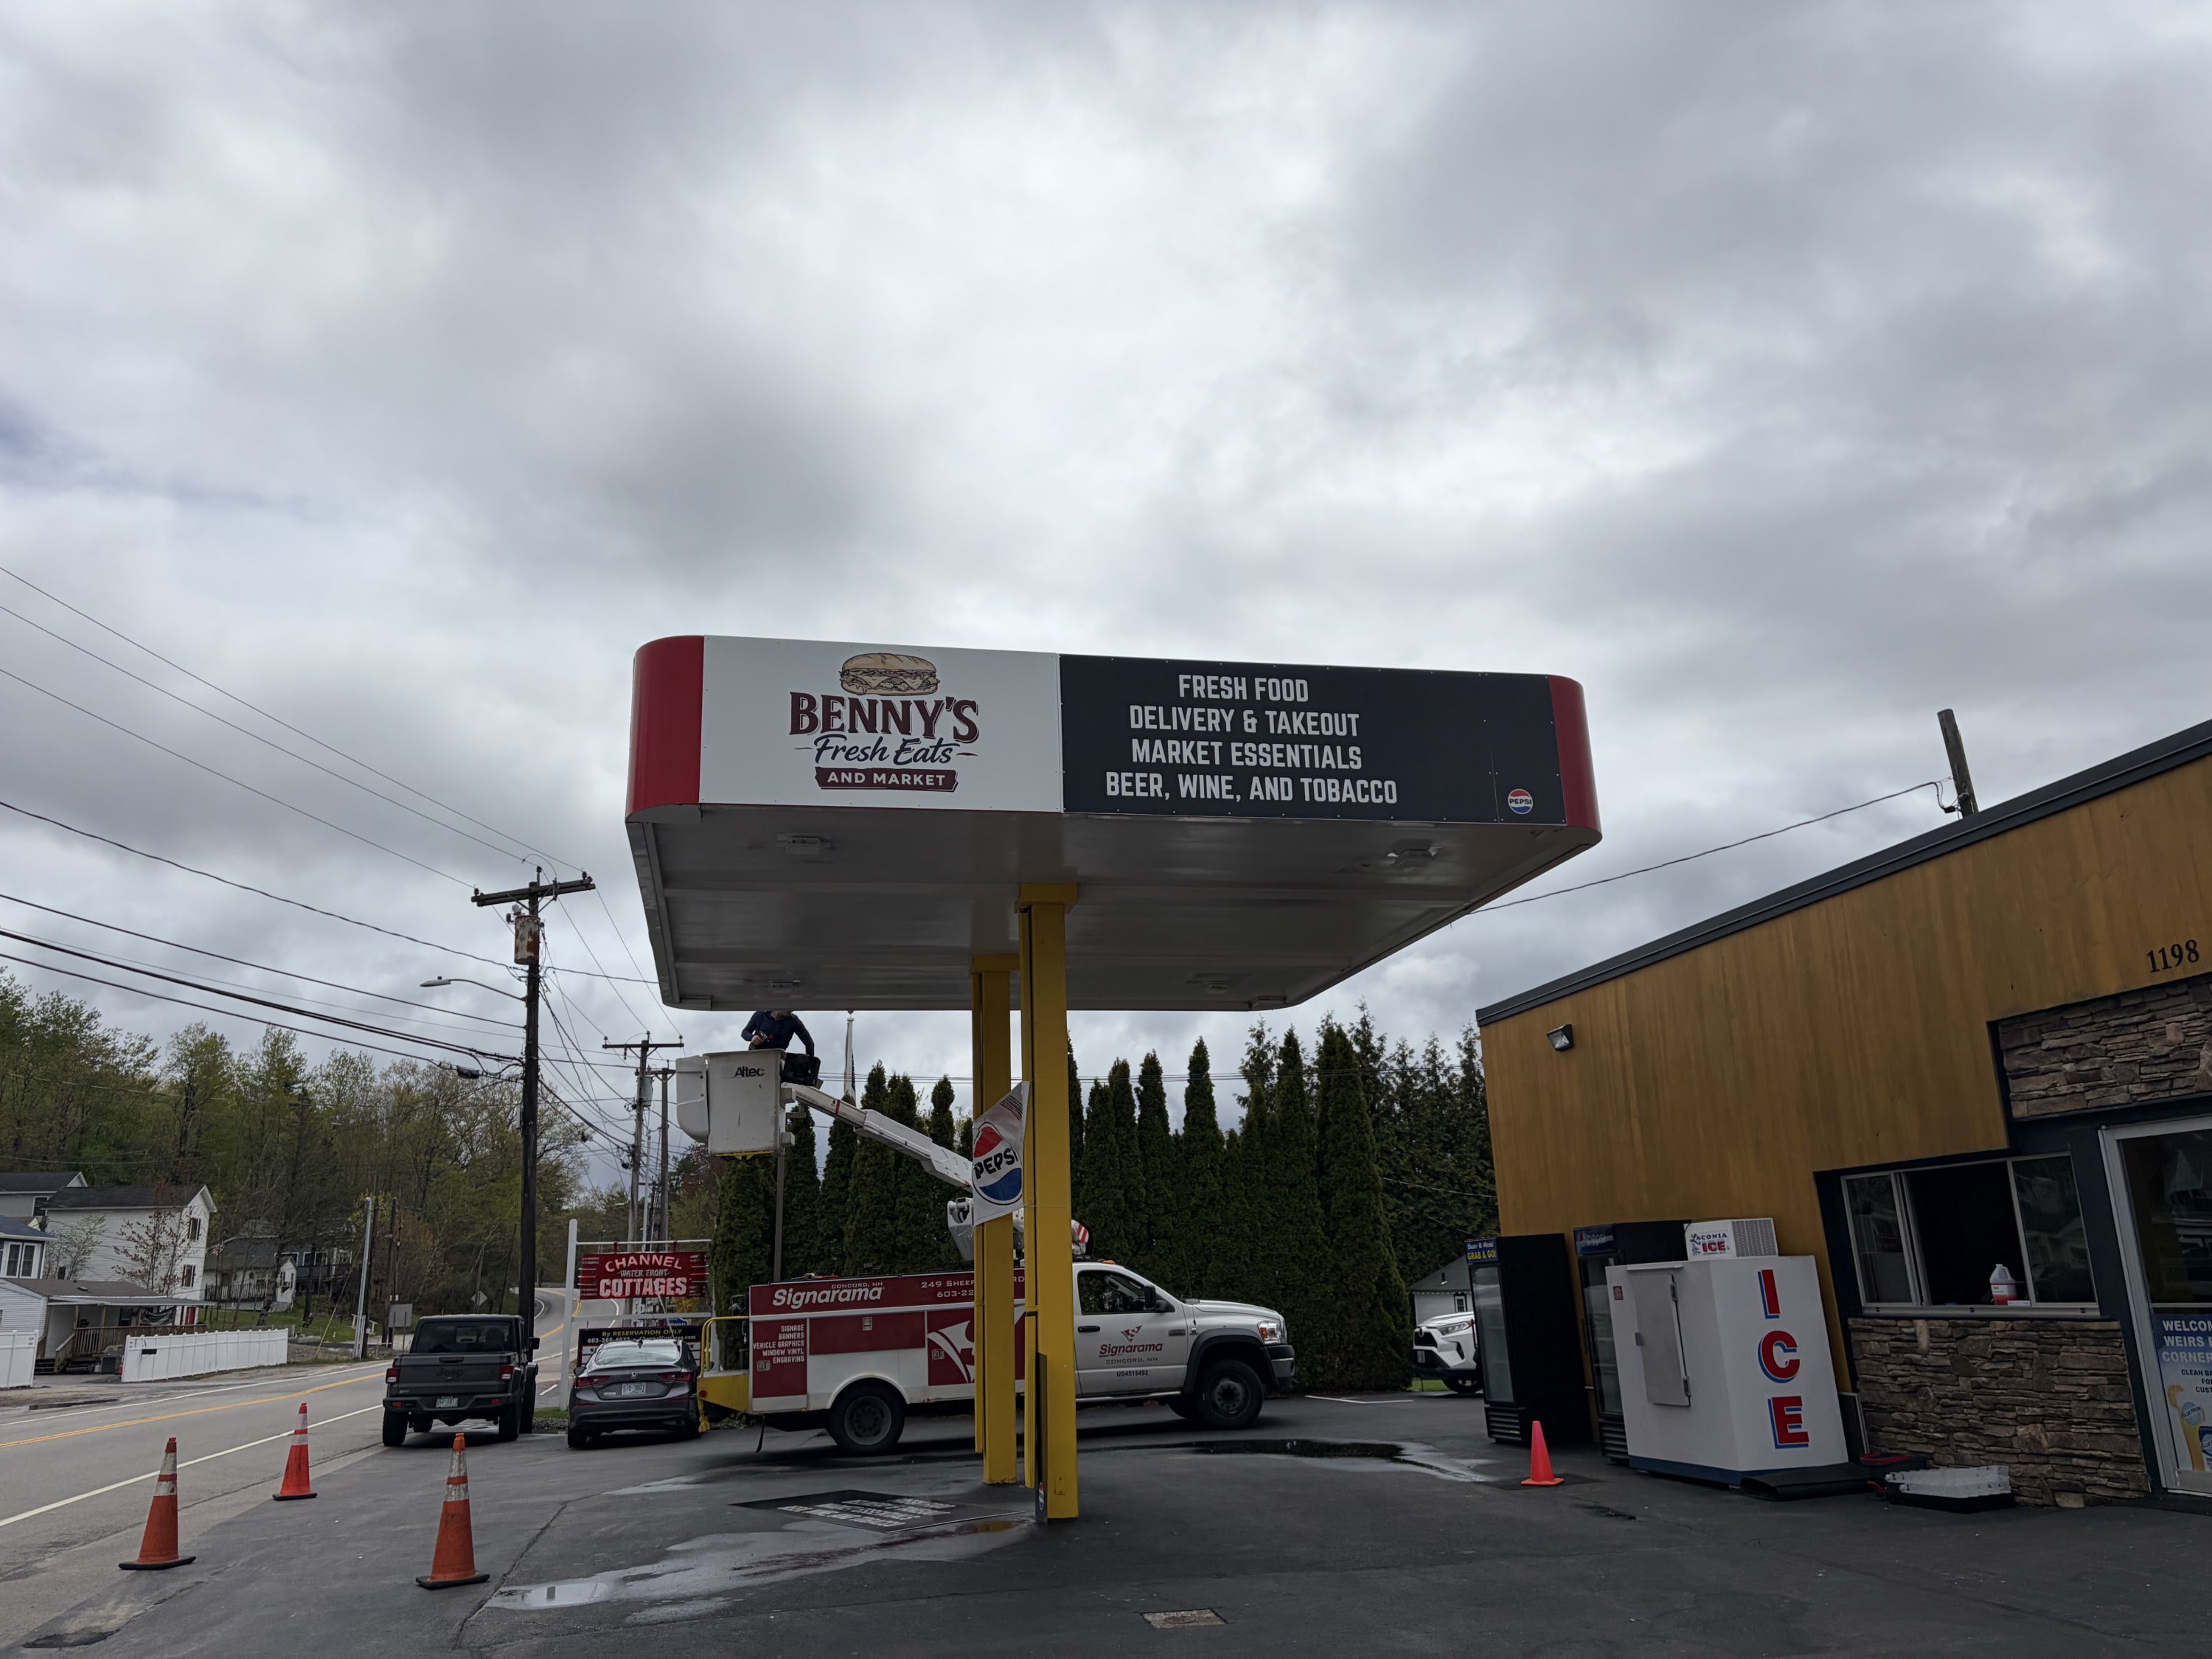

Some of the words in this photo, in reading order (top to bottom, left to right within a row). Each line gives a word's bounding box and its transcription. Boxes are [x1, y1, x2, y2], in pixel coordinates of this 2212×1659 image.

[1179, 675, 1247, 700] FRESH
[1254, 678, 1309, 703] FOOD
[789, 692, 979, 743] BENNY'S
[1130, 705, 1234, 732] DELIVERY
[1243, 710, 1257, 733] &
[1265, 711, 1359, 737] TAKEOUT
[813, 734, 889, 765] Fresh
[893, 738, 959, 765] Eats
[1132, 739, 1222, 765] MARKET
[1231, 742, 1362, 769] ESSENTIALS
[827, 772, 866, 784] AND
[872, 773, 946, 786] MARKET
[1106, 771, 1169, 800] BEER,
[1178, 774, 1241, 802] WINE,
[1249, 776, 1293, 801] AND
[1300, 778, 1397, 804] TOBACCO
[2146, 939, 2199, 973] 1198
[734, 1066, 765, 1077] Altec
[974, 1148, 1018, 1180] PEPSI
[1690, 1233, 1728, 1245] LACONIA
[1703, 1241, 1726, 1252] ICE
[605, 1254, 683, 1273] CHANNEL
[620, 1269, 643, 1277] WATER
[646, 1268, 669, 1276] FRONT
[599, 1277, 687, 1297] COTTAGES
[773, 1287, 883, 1310] Signarama
[781, 1324, 804, 1332] SIGNAGE
[753, 1341, 776, 1349] VEHICLE
[777, 1340, 804, 1348] GRAPHICS
[1099, 1343, 1163, 1356] Signarama
[2163, 1336, 2205, 1347] WEIRS
[762, 1349, 785, 1357] WINDOW
[773, 1355, 804, 1364] ENGRAVING
[1758, 1269, 1809, 1449] ICE
[2162, 1352, 2212, 1363] CORNER
